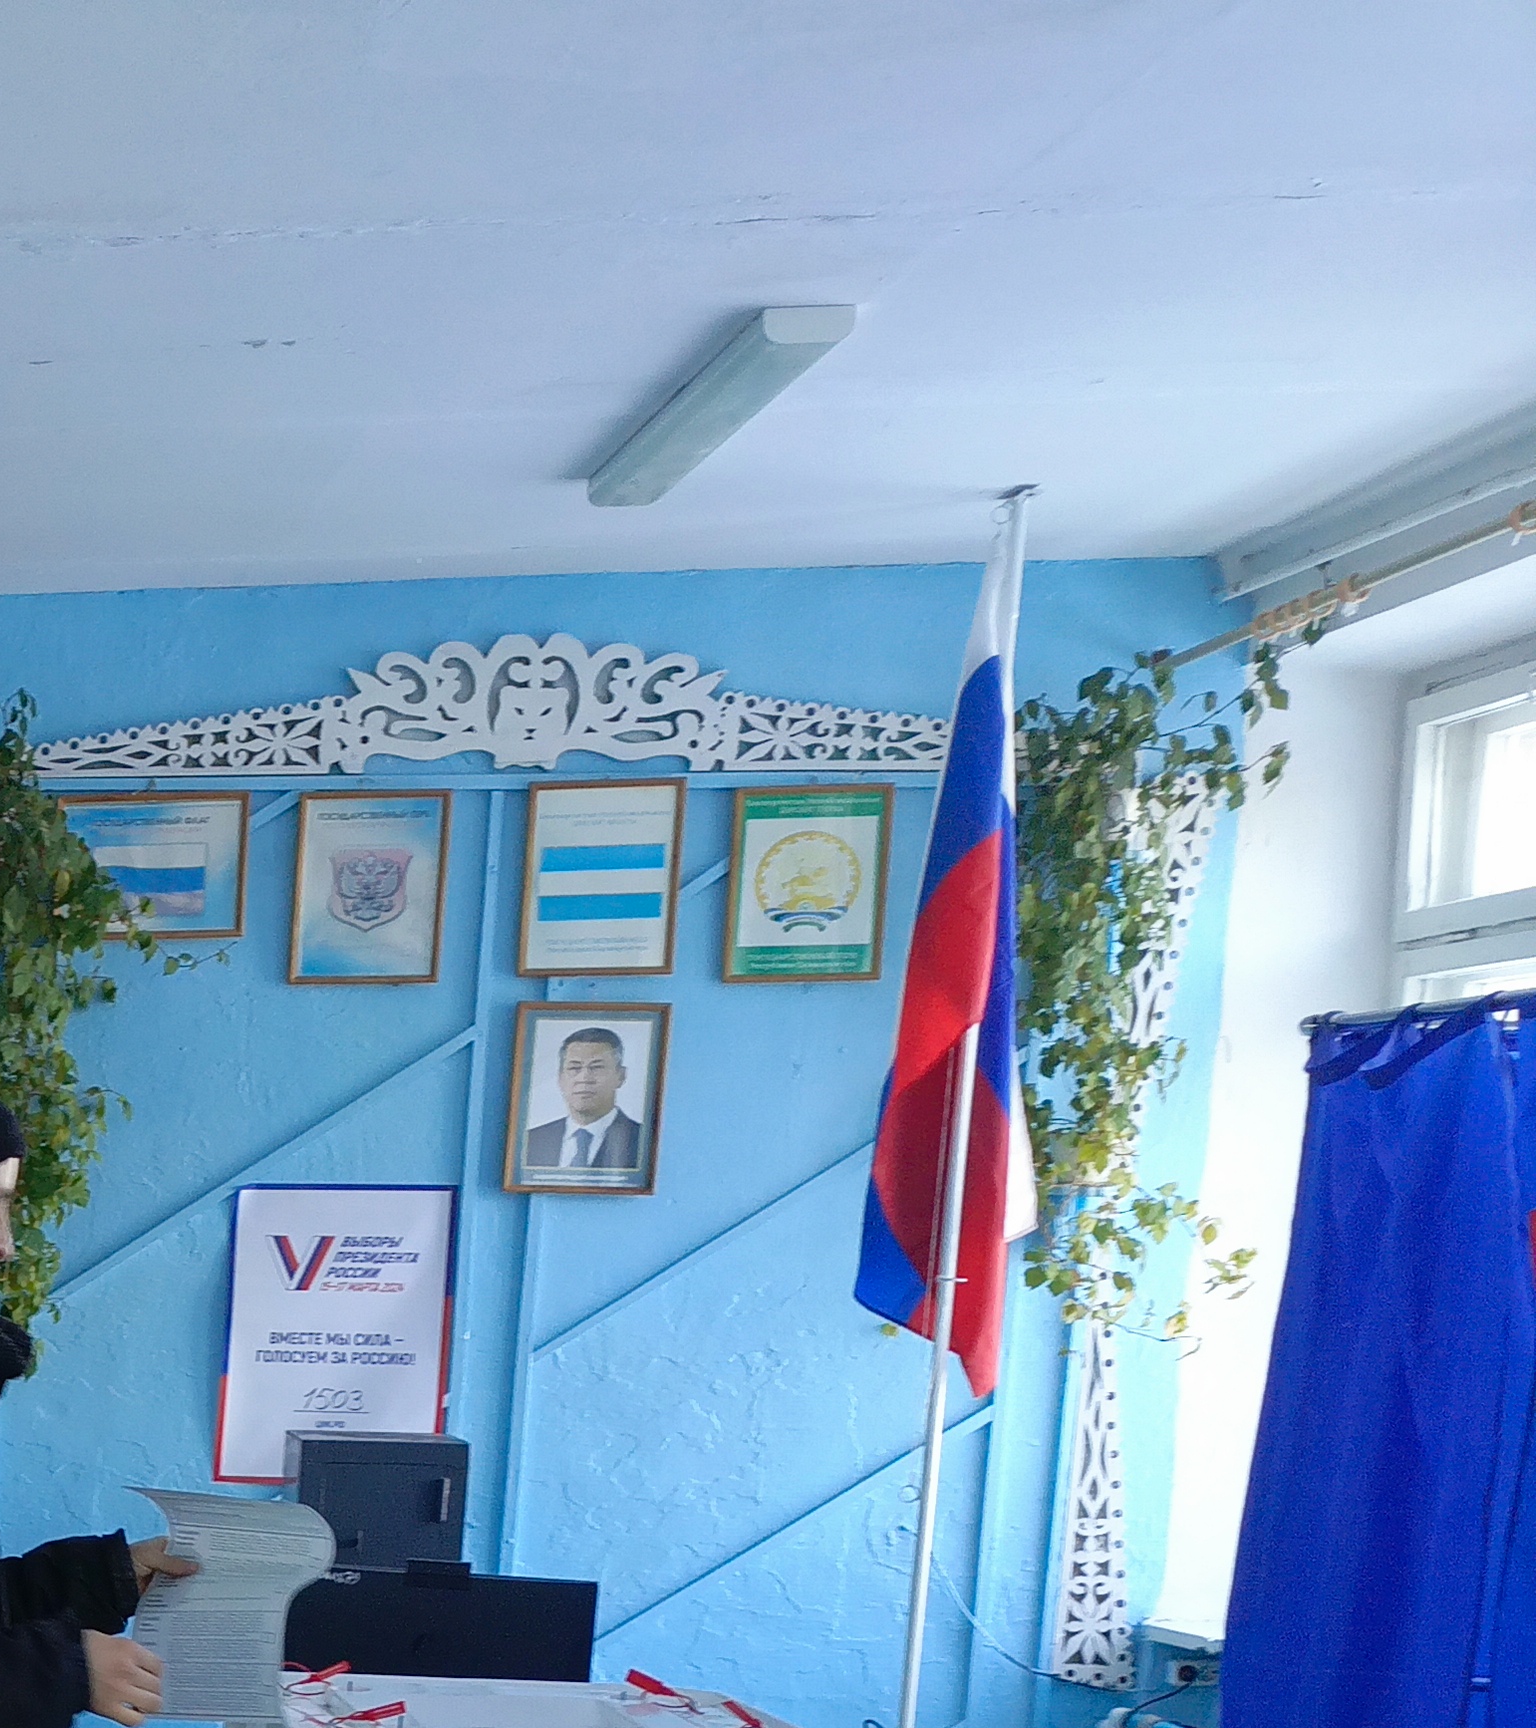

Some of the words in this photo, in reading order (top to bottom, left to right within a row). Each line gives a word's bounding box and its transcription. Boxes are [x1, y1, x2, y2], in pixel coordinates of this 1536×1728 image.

[340, 1236, 404, 1248] ВЫБОРЫ
[333, 1251, 420, 1264] ПРЕЗИДЕНТА
[324, 1267, 382, 1278] РОССИИ
[269, 1332, 323, 1345] ВМЕСТЕ
[325, 1333, 351, 1345] МЫ
[353, 1333, 391, 1346] СИЛА
[255, 1350, 327, 1363] ГОЛОСУЕМ
[330, 1351, 348, 1364] ЗА
[350, 1352, 416, 1365] РОССИЮ!
[303, 1387, 364, 1411] 1503
